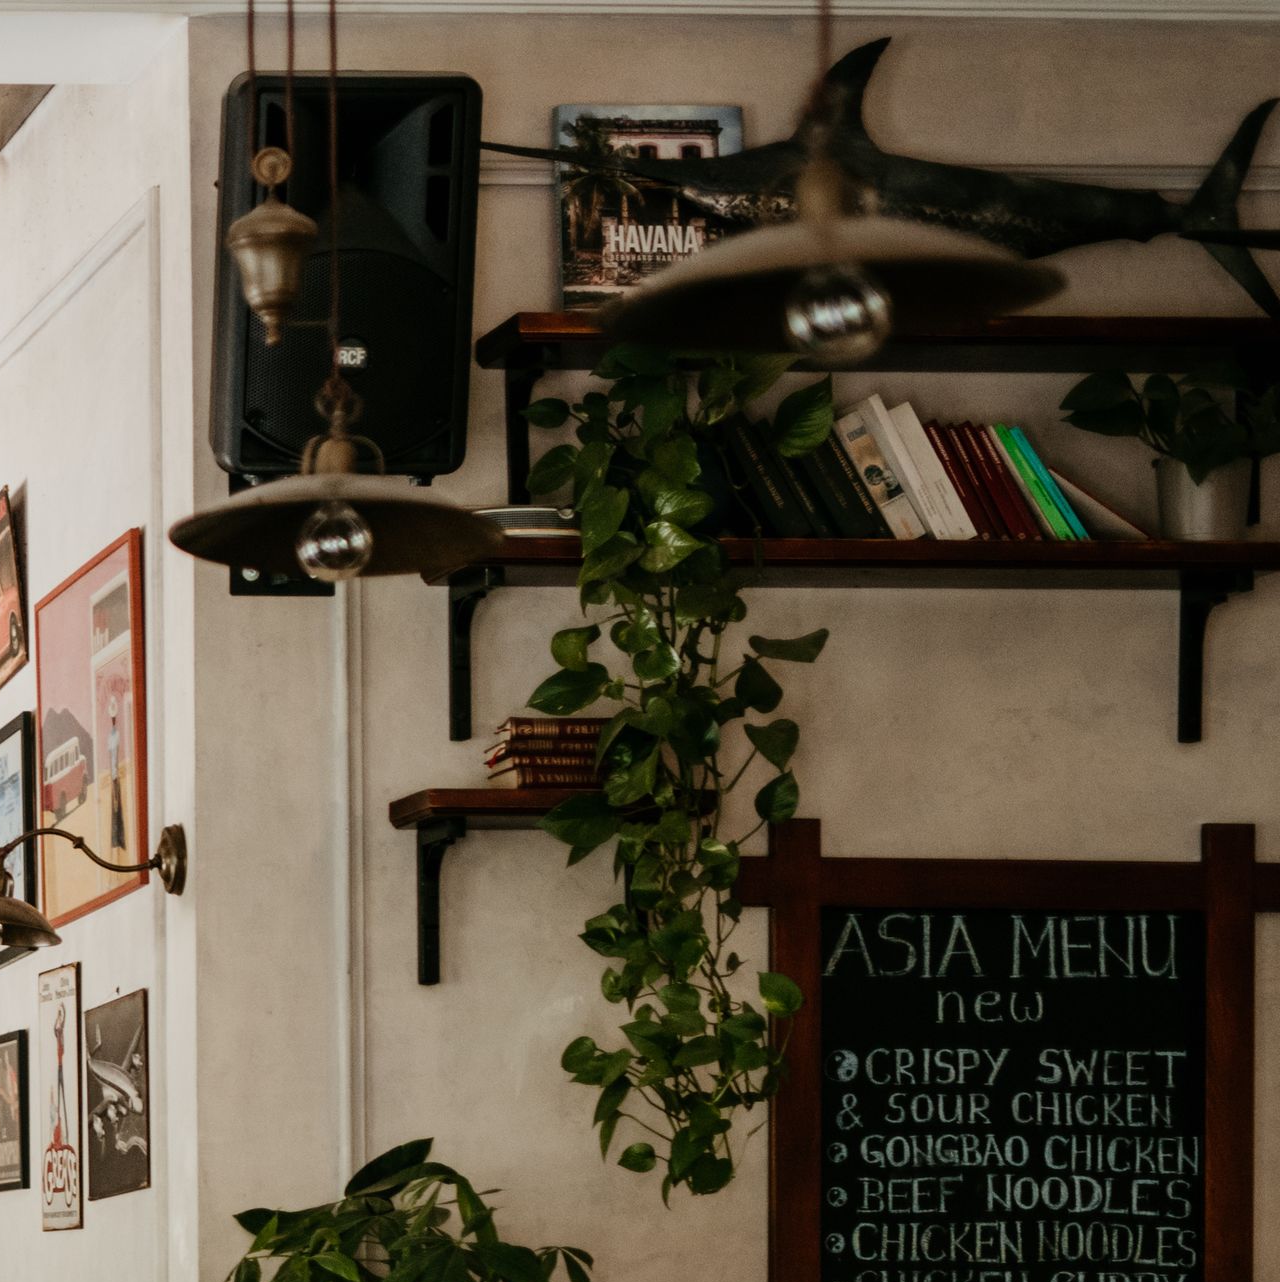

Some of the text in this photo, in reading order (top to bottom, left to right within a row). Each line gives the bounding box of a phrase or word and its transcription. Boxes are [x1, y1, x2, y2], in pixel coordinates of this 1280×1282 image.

[609, 224, 699, 253] HAVANA
[338, 348, 366, 366] RCF
[823, 912, 1181, 980] ASIA MENU
[935, 988, 1044, 1024] new
[866, 1047, 1187, 1088] CRISPY SWEET
[836, 1092, 1173, 1130] & SOUR CHICKEN
[861, 1135, 1199, 1175] GONGBAO CHICKEN
[857, 1174, 1192, 1218] BEEF NOODLES
[852, 1221, 1197, 1268] CHICKEN NOODLES
